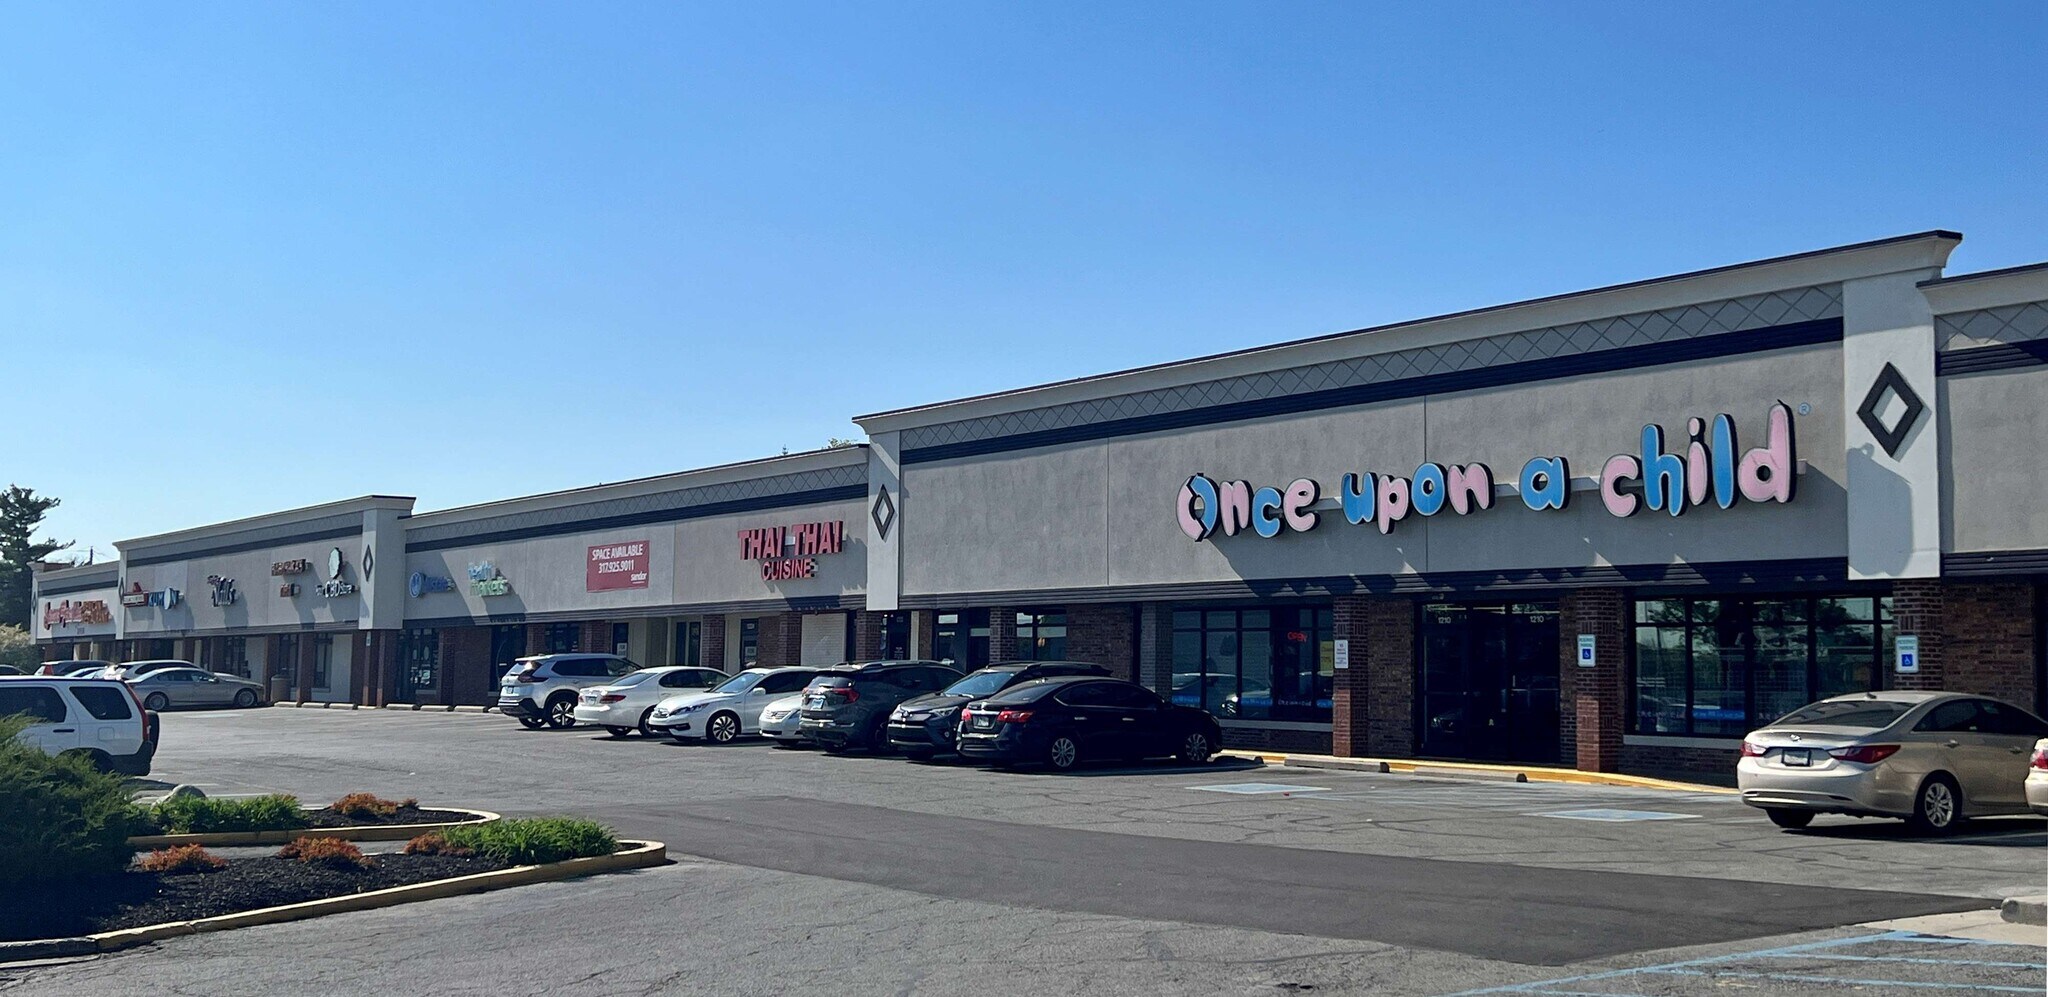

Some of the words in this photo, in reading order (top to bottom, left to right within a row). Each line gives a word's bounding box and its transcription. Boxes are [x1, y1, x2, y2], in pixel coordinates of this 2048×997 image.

[1176, 472, 1320, 542] Once
[1341, 462, 1495, 535] upon
[1519, 456, 1571, 511] a
[1600, 401, 1797, 517] child
[738, 526, 786, 560] THAI
[792, 520, 843, 555] THAI
[592, 549, 611, 561] SPACE
[611, 544, 643, 558] AVAILABLE
[598, 560, 634, 574] 317.925.9011
[762, 558, 814, 581] CUISINE
